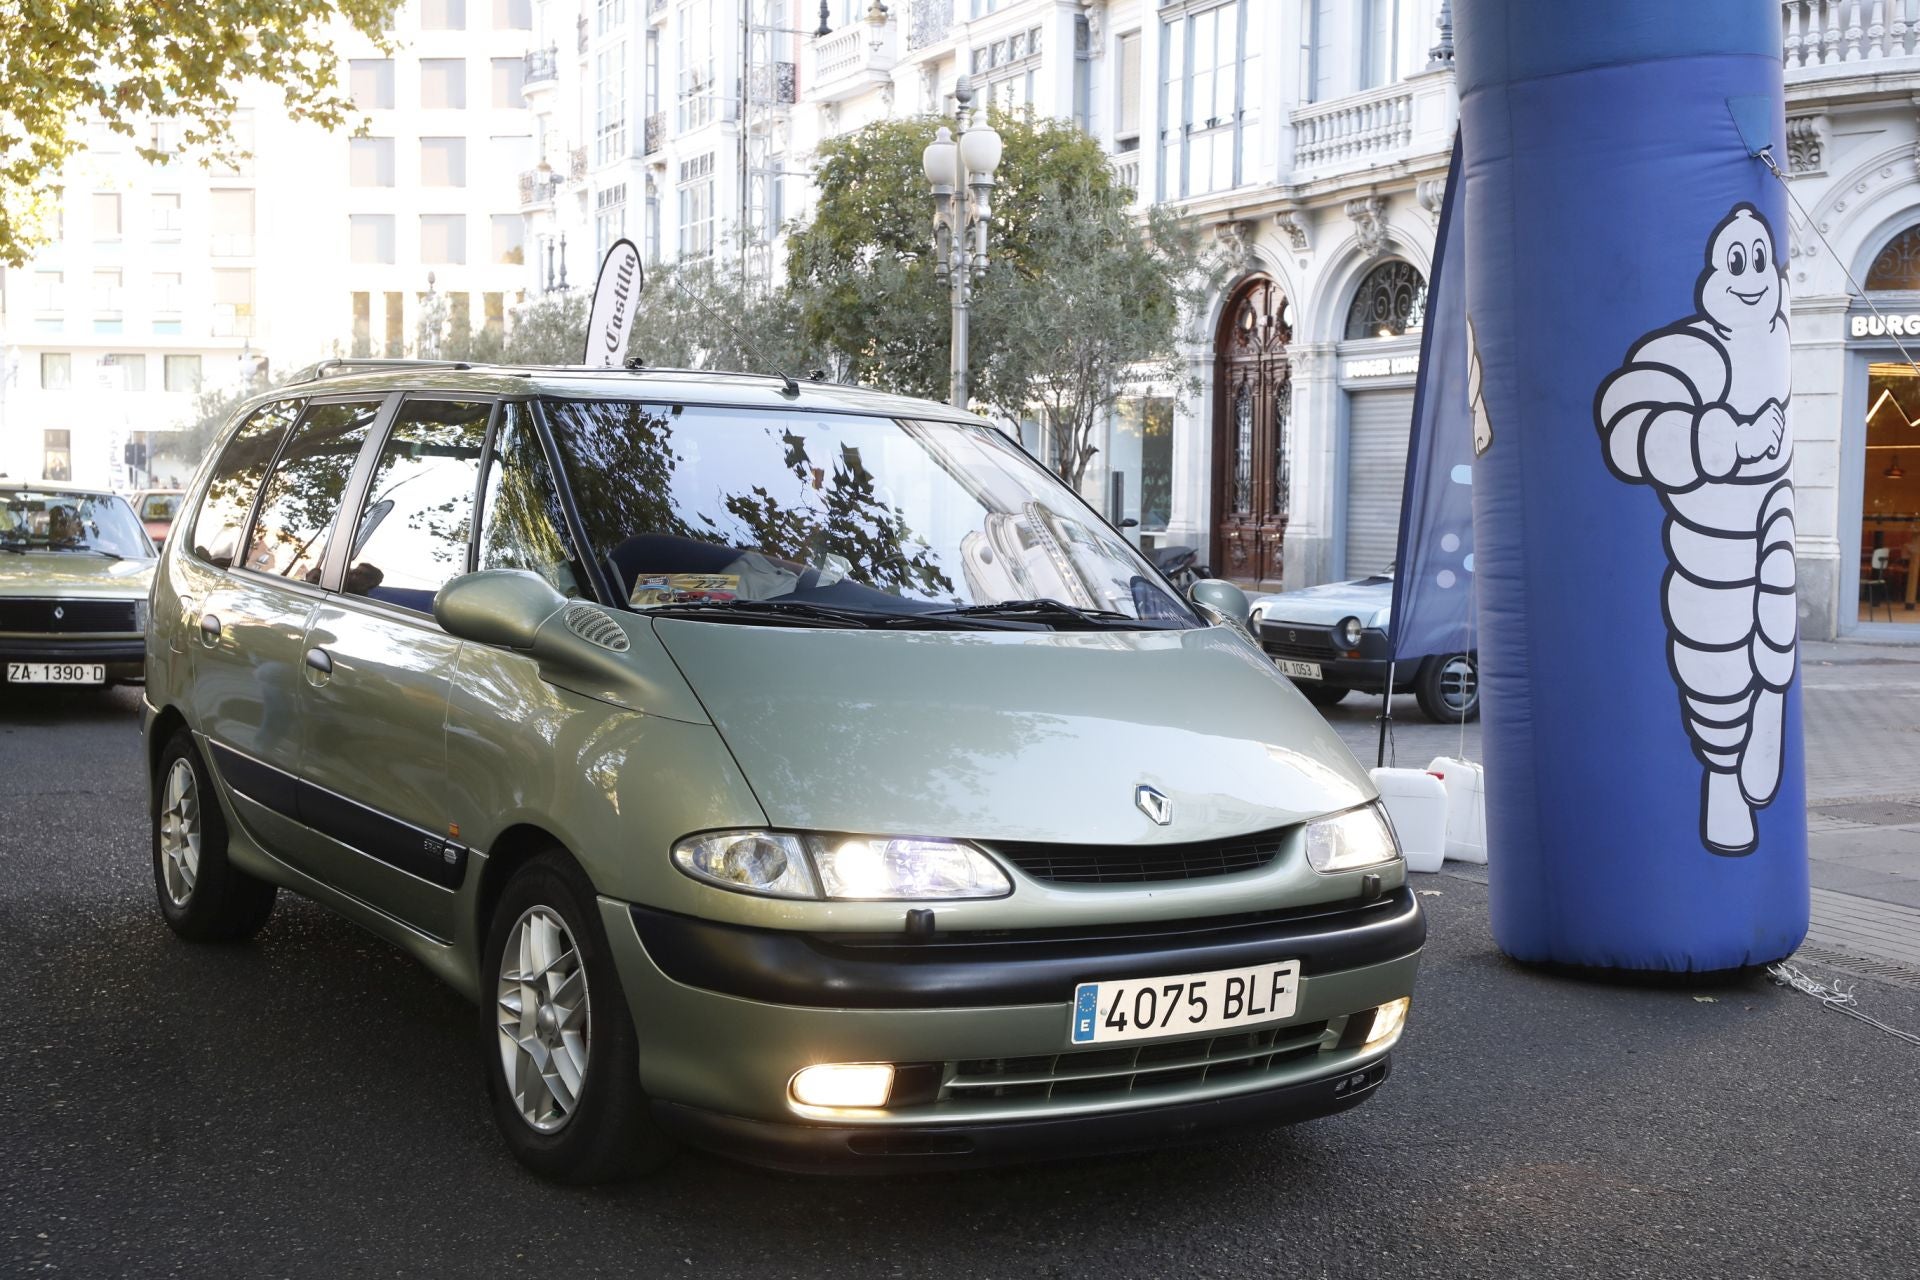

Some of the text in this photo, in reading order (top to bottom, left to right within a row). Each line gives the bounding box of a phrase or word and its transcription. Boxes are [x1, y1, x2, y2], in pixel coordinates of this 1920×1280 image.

[605, 253, 636, 353] Castilla
[1851, 314, 1920, 337] BURG
[693, 580, 725, 589] 222
[1292, 663, 1312, 676] 1053
[1105, 969, 1292, 1032] 4075 BLF
[1080, 1019, 1091, 1032] E
